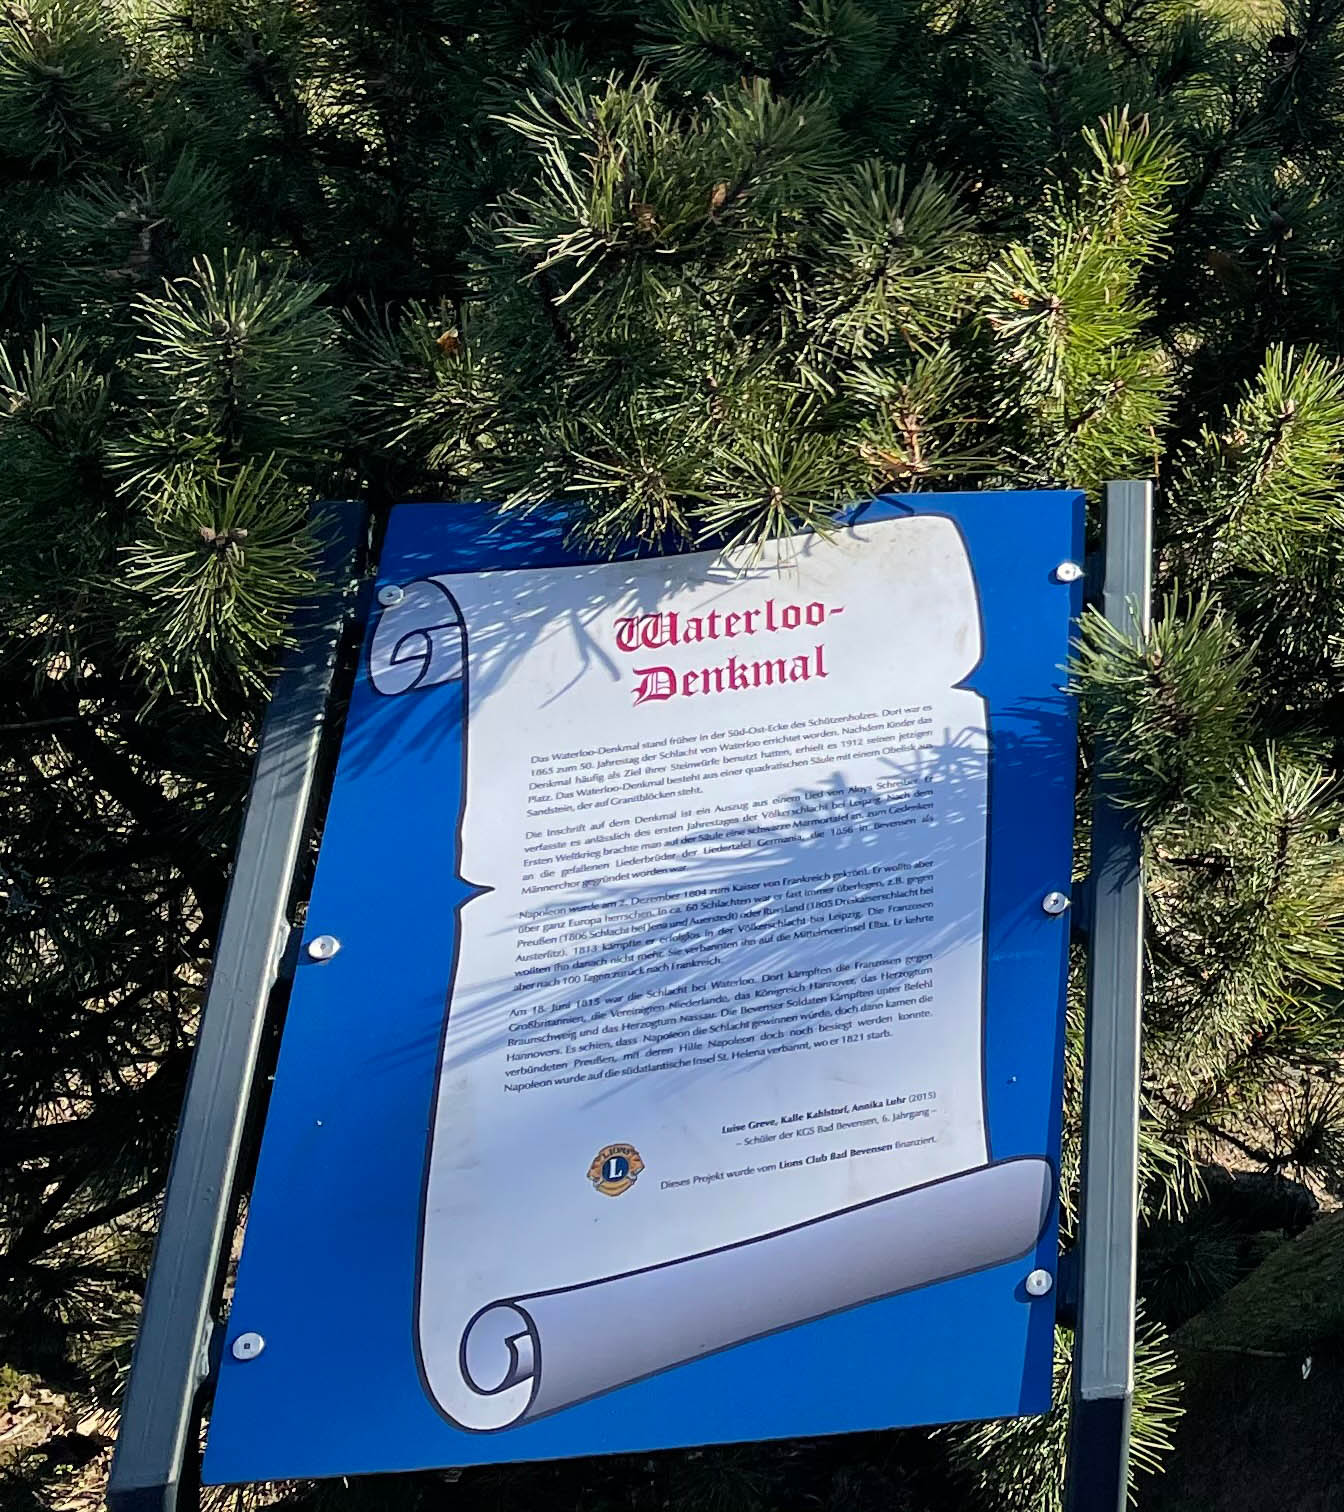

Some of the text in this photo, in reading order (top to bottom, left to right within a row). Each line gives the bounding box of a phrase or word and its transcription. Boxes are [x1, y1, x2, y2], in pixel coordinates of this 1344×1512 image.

[613, 598, 847, 653] Waterloo-
[630, 643, 830, 708] Denkmal
[778, 1129, 793, 1139] der
[796, 1125, 814, 1136] KGS
[817, 1121, 833, 1133] Bad
[609, 1158, 622, 1178] L
[757, 1163, 776, 1172] vom
[830, 1148, 847, 1159] Bad
